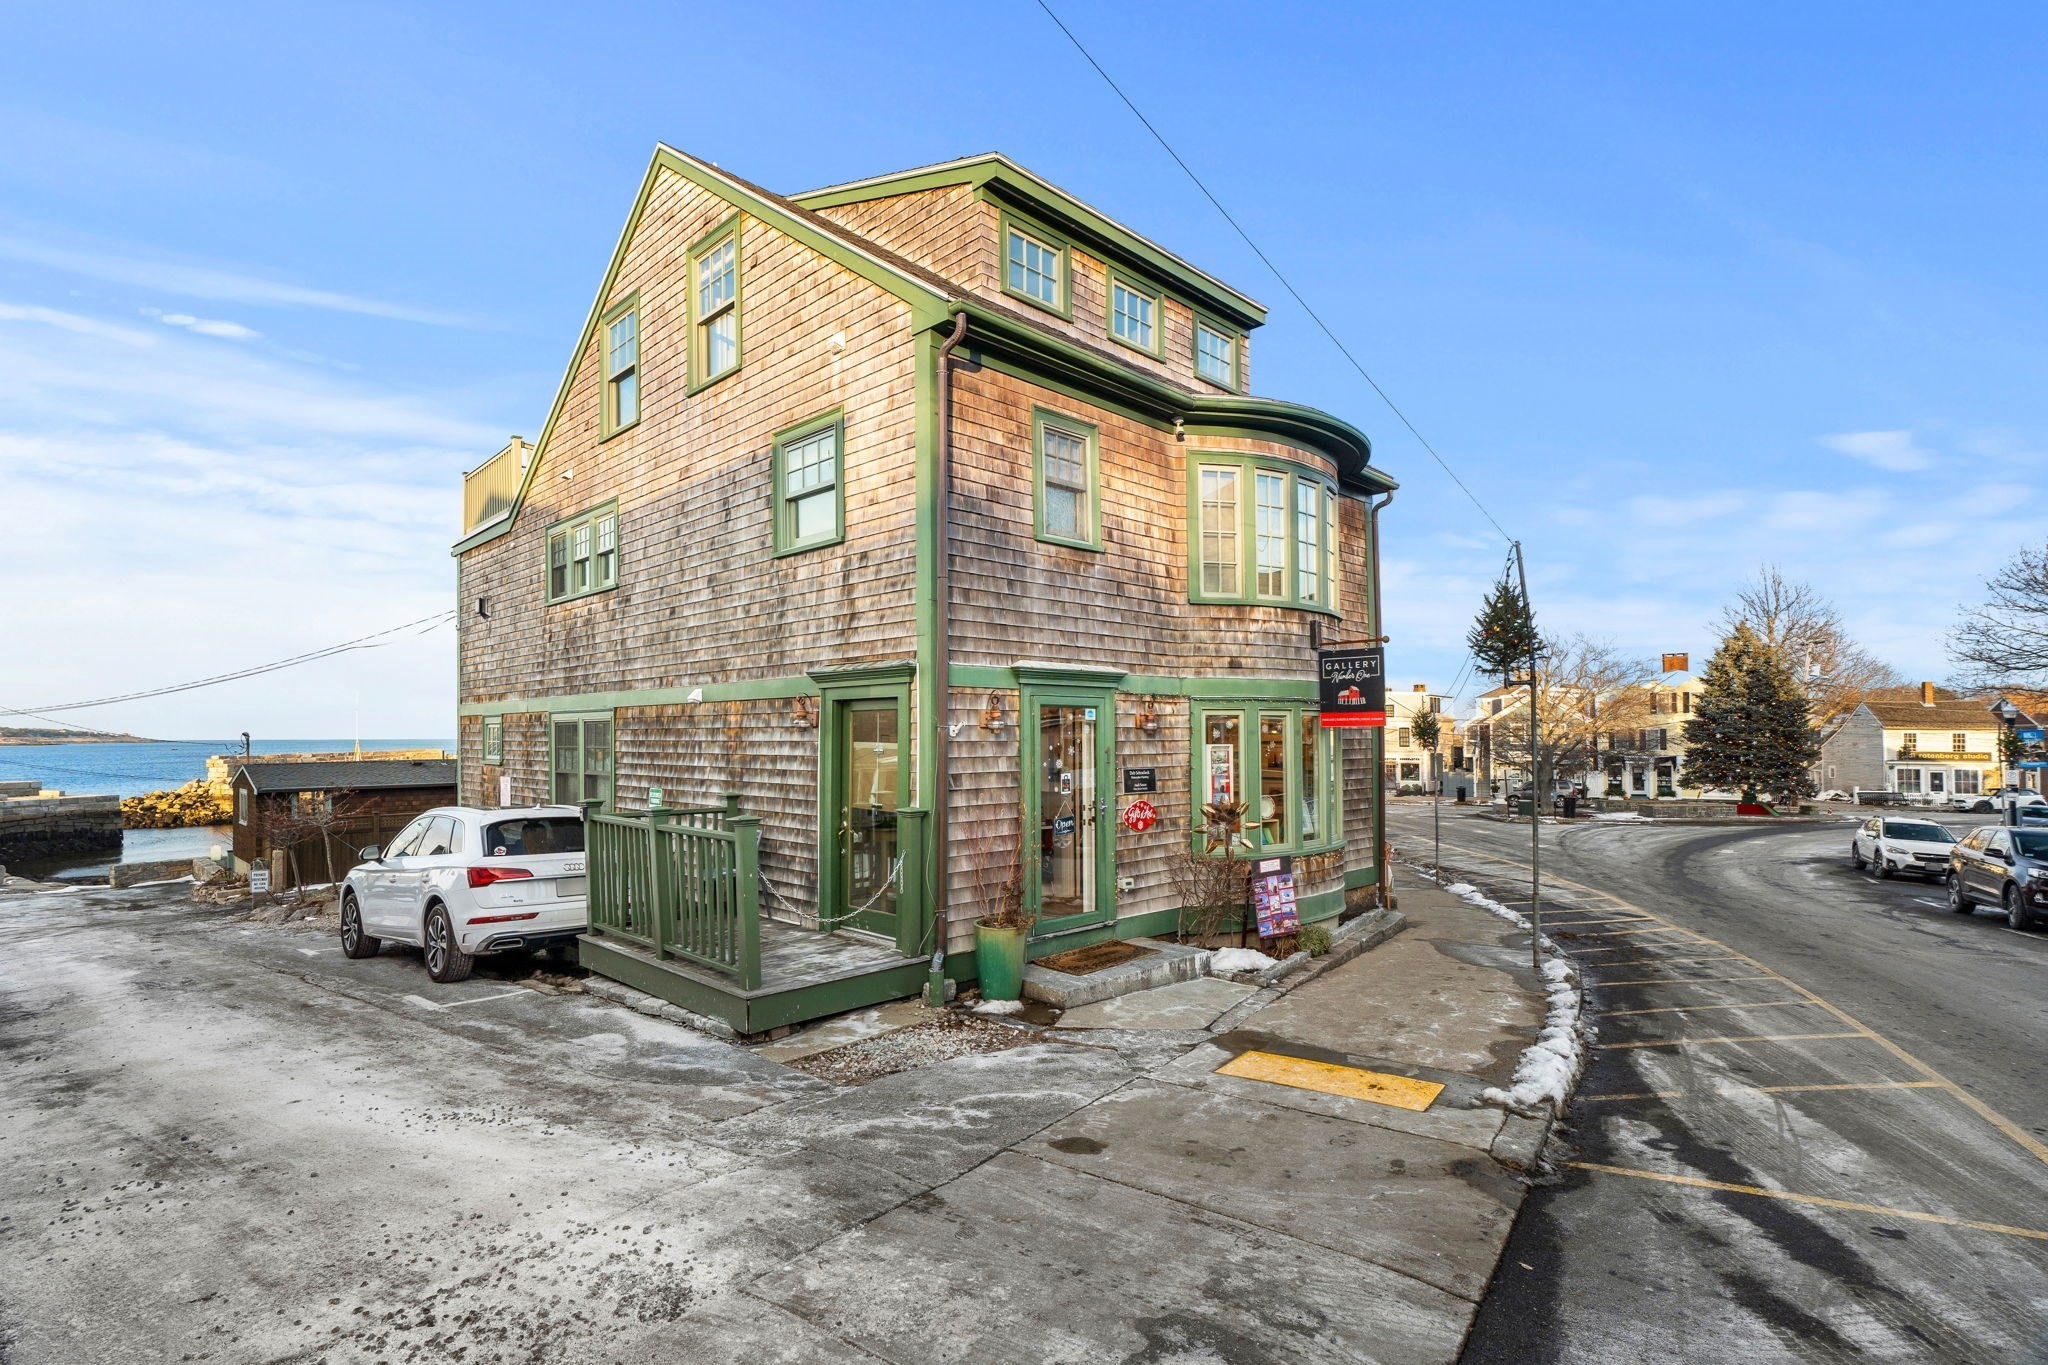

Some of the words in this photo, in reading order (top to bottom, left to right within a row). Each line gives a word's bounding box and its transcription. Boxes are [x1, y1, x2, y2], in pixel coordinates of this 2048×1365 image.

[1325, 660, 1376, 670] GALLERY
[1331, 669, 1355, 683] Number
[1355, 670, 1370, 682] One
[1055, 819, 1074, 830] Open
